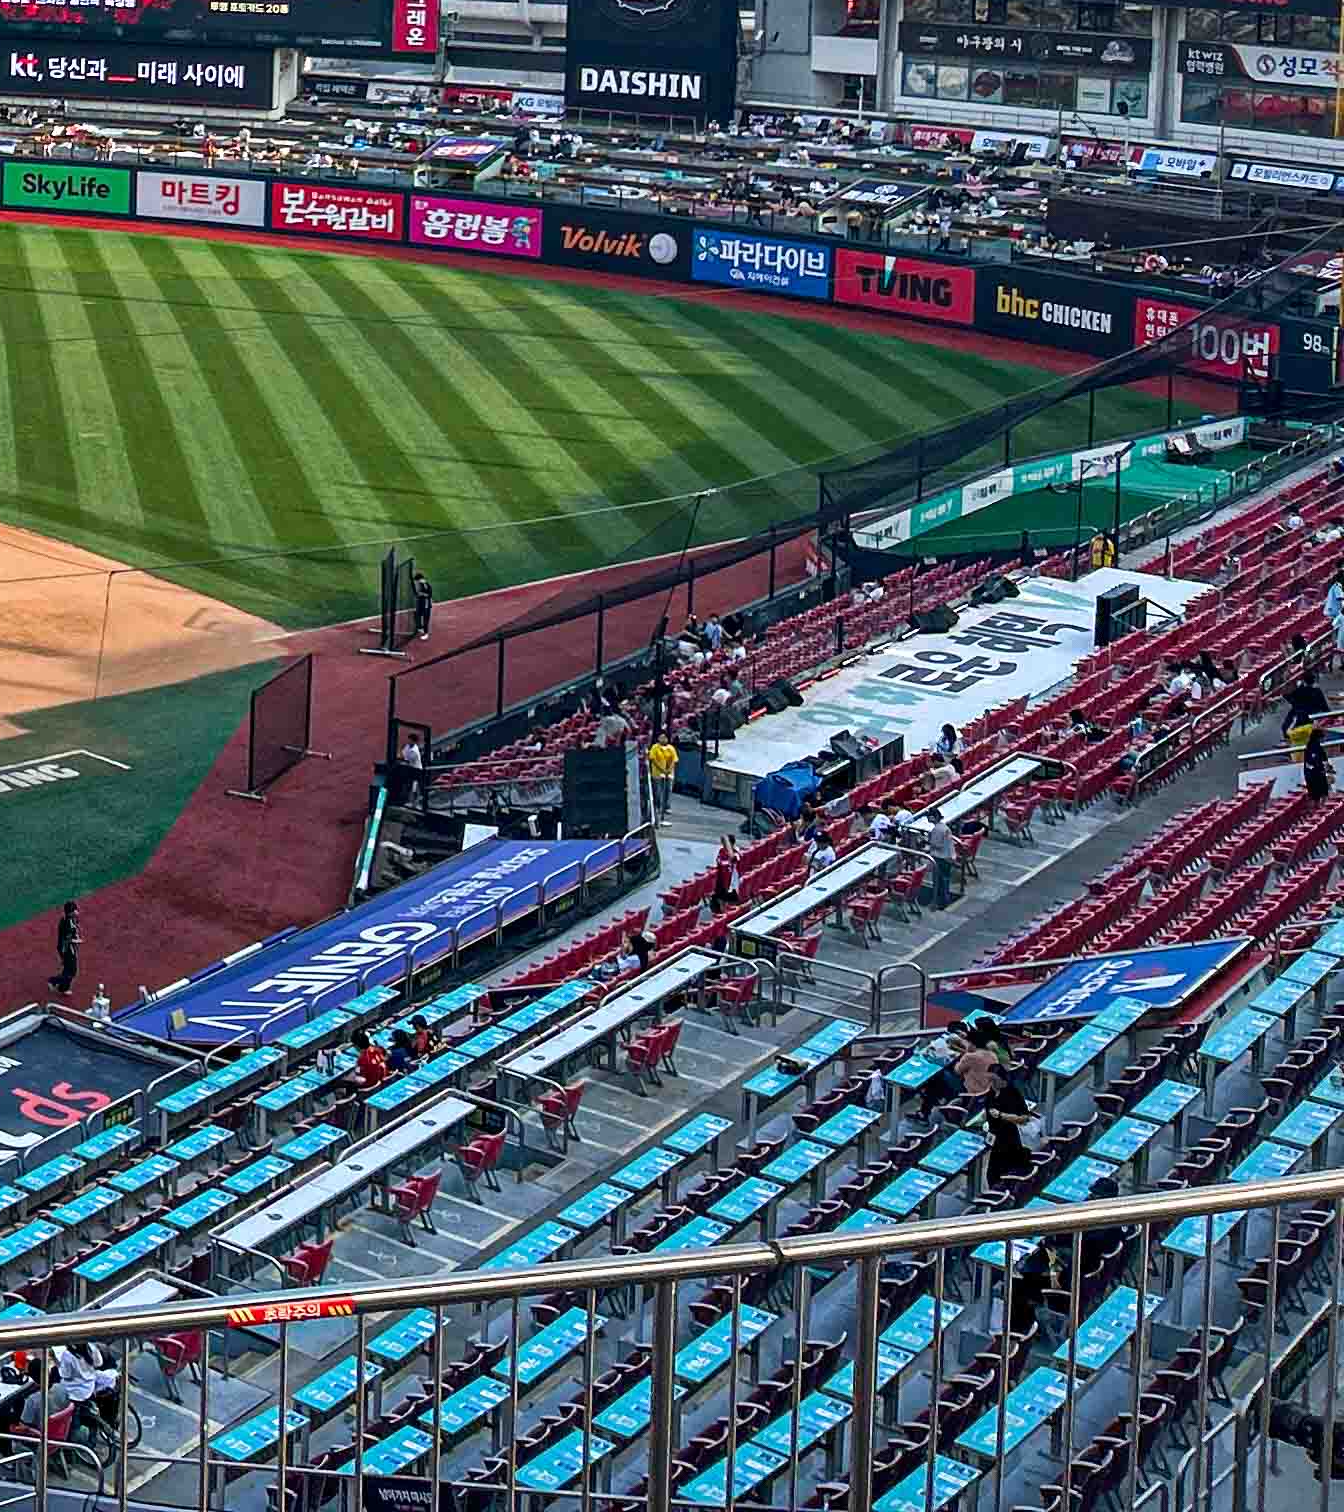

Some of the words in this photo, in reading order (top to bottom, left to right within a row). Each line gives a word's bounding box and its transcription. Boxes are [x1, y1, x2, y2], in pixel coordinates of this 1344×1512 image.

[49, 57, 107, 81] 당신과
[138, 62, 177, 85] 미래
[183, 64, 245, 88] 사이에
[580, 67, 702, 100] DAISHIN
[22, 173, 111, 201] SkyLife
[160, 179, 241, 216] 마트킹
[279, 185, 395, 234] 본수원갈비
[421, 210, 511, 246] 홈런볼
[559, 225, 642, 258] Volvik
[855, 255, 953, 308] TVING
[996, 285, 1040, 320] bhc
[1040, 301, 1113, 335] CHICKEN
[260, 921, 441, 995] GENIE
[187, 999, 295, 1031] TV
[12, 1081, 112, 1128] ds
[262, 1302, 322, 1322] 추락주의
